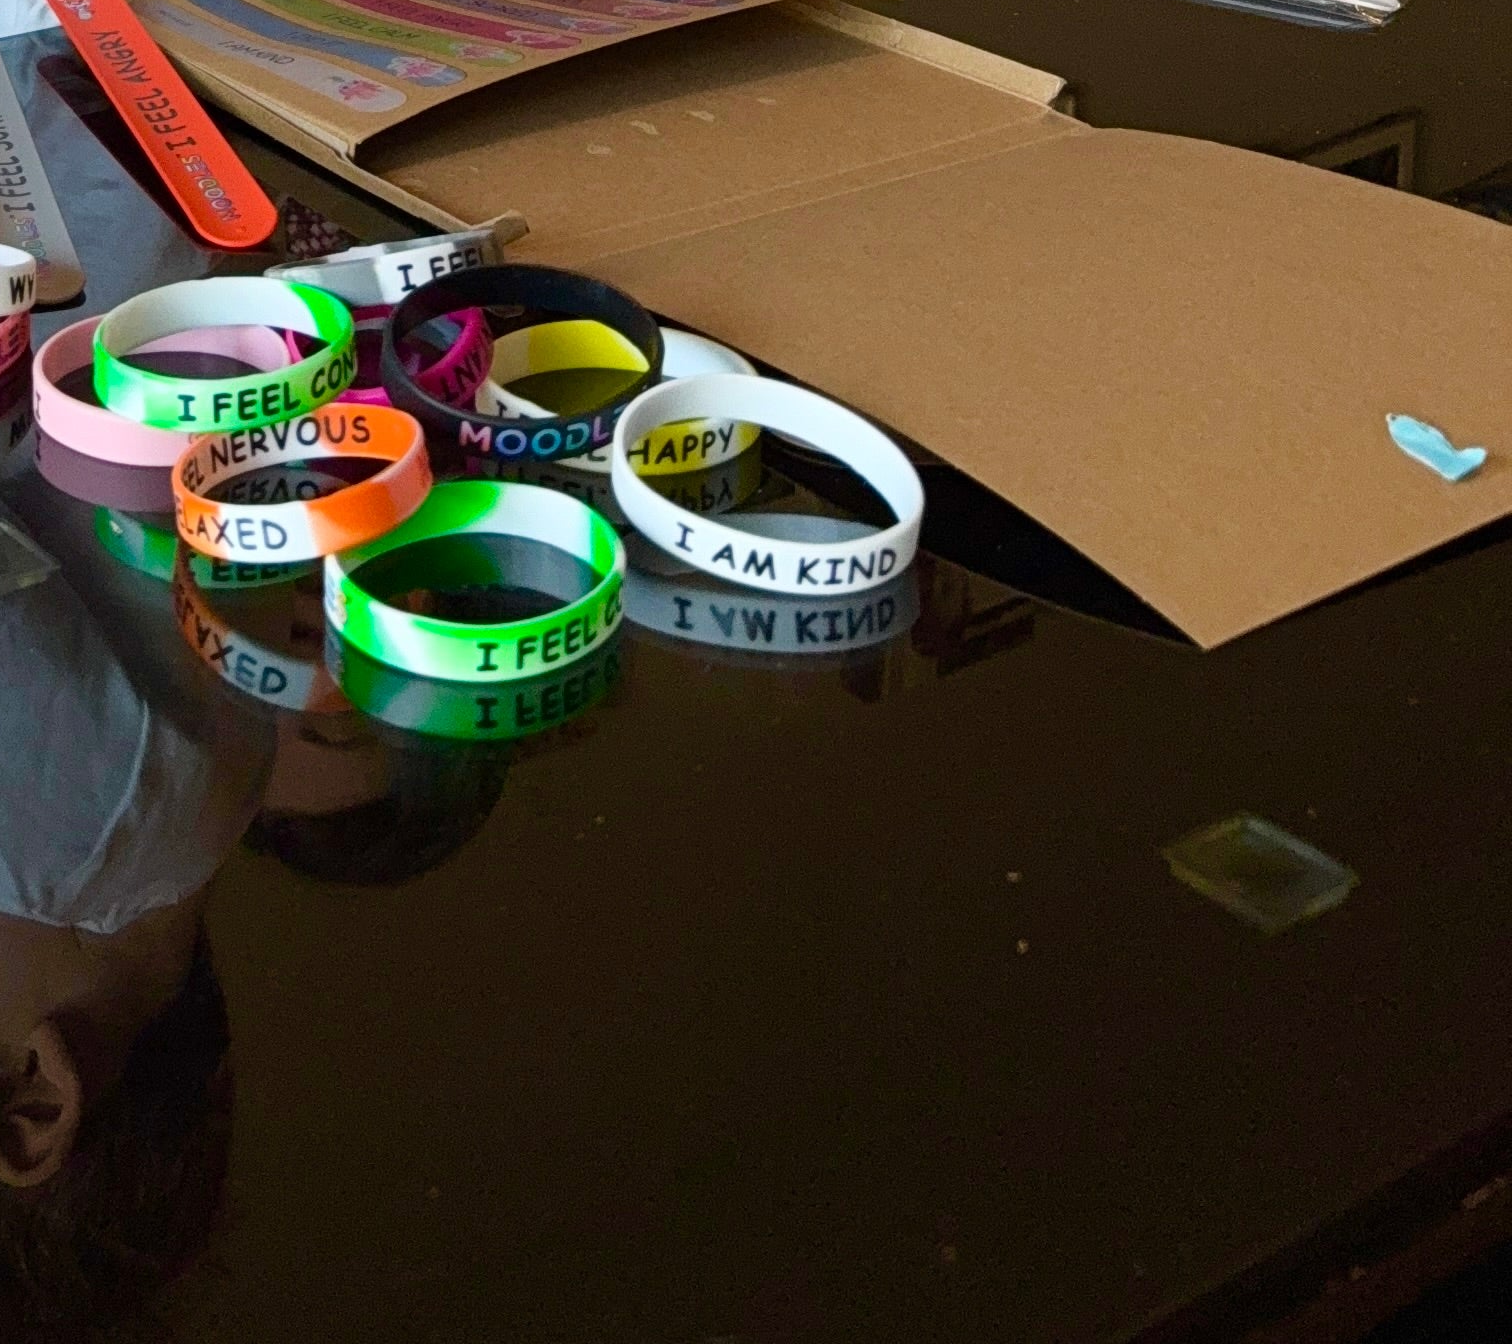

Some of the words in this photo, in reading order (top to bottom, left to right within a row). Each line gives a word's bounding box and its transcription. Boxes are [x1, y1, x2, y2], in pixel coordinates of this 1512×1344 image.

[90, 30, 152, 84] ANGRY
[136, 87, 187, 135] FEEL
[165, 136, 198, 152] I
[2, 202, 36, 213] I
[396, 263, 417, 292] I
[177, 394, 197, 422] I
[213, 381, 301, 424] FEEL
[210, 415, 370, 473] NERVOUS
[458, 405, 626, 455] MOODL
[626, 422, 735, 466] HAPPY
[176, 497, 288, 551] LAXED
[674, 521, 696, 553] I
[711, 543, 776, 581] AM
[796, 548, 898, 586] KIND
[476, 642, 500, 672] I
[516, 614, 598, 671] FEEL
